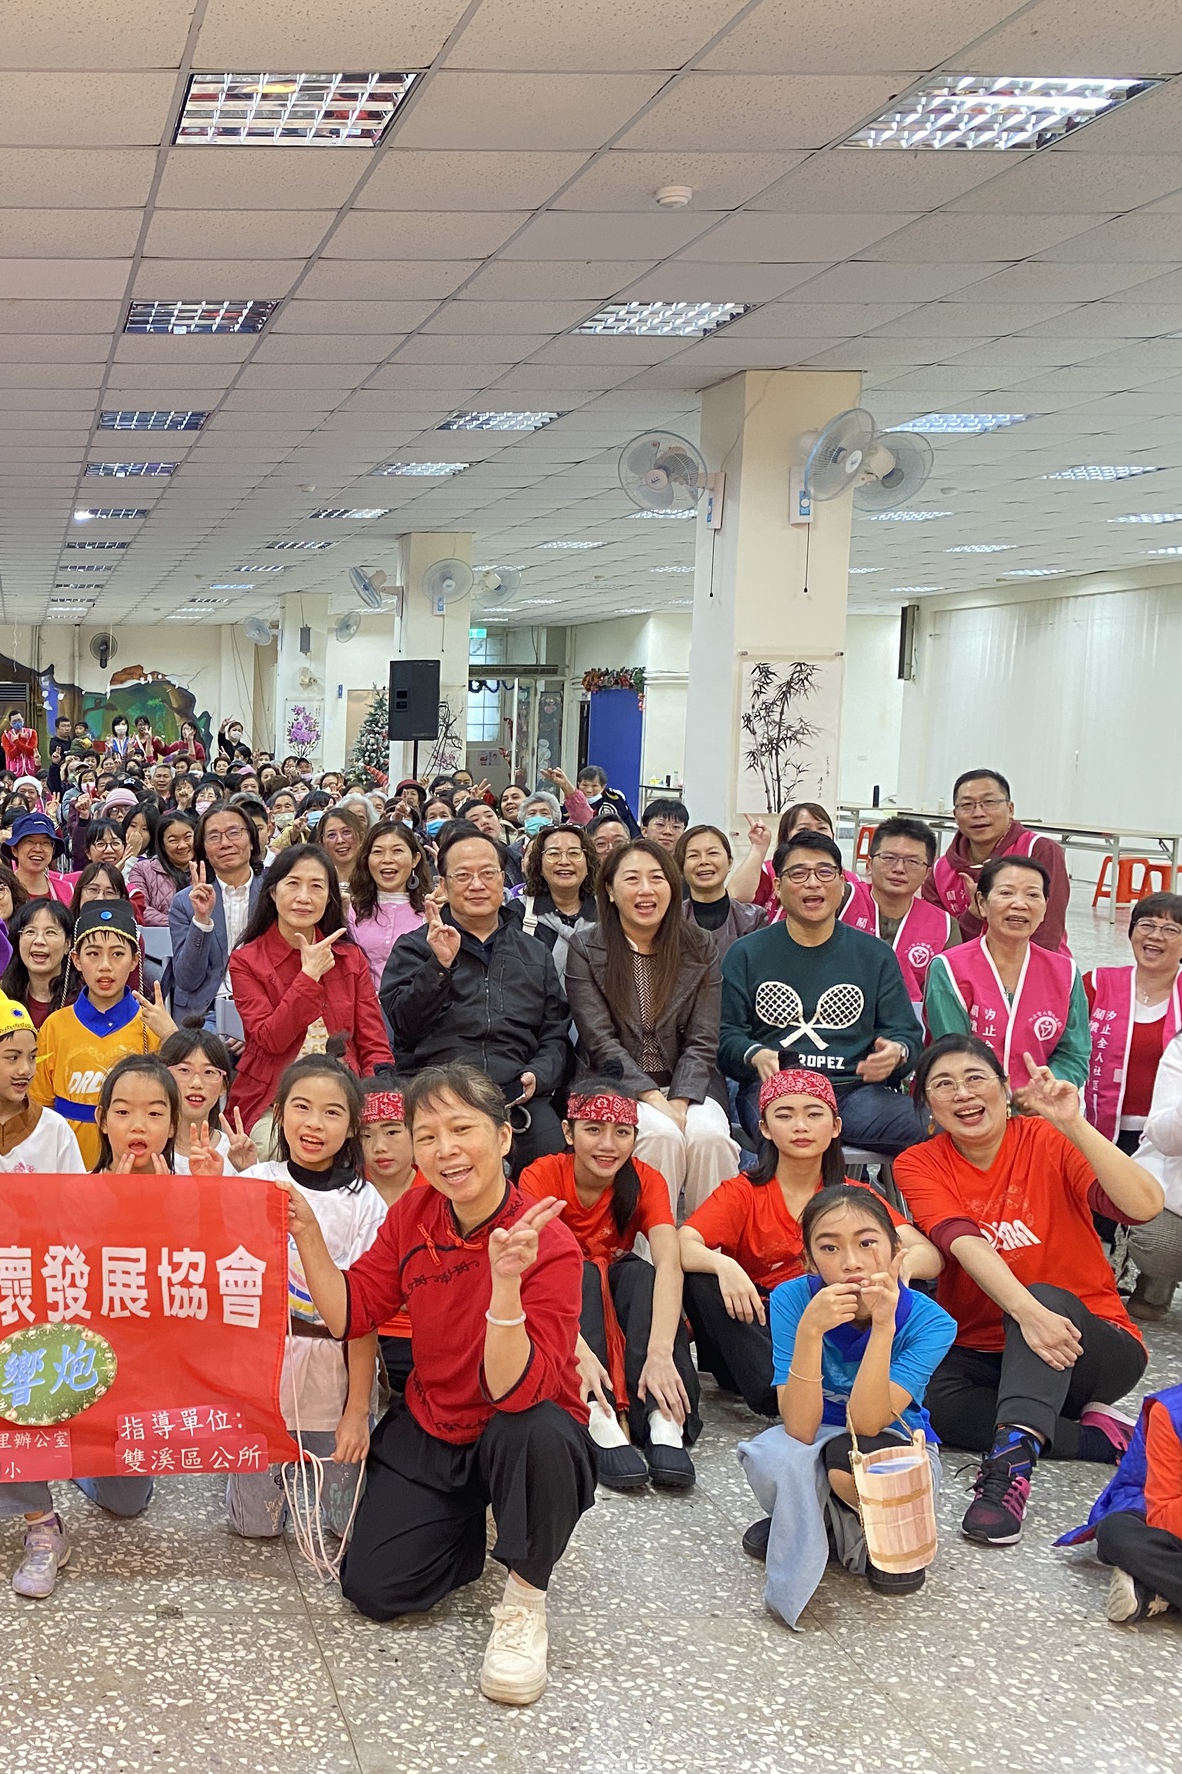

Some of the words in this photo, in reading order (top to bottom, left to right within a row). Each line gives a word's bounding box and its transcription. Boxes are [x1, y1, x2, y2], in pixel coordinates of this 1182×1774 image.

[0, 1339, 100, 1408] 響炮
[120, 1444, 263, 1473] 雙溪區公所
